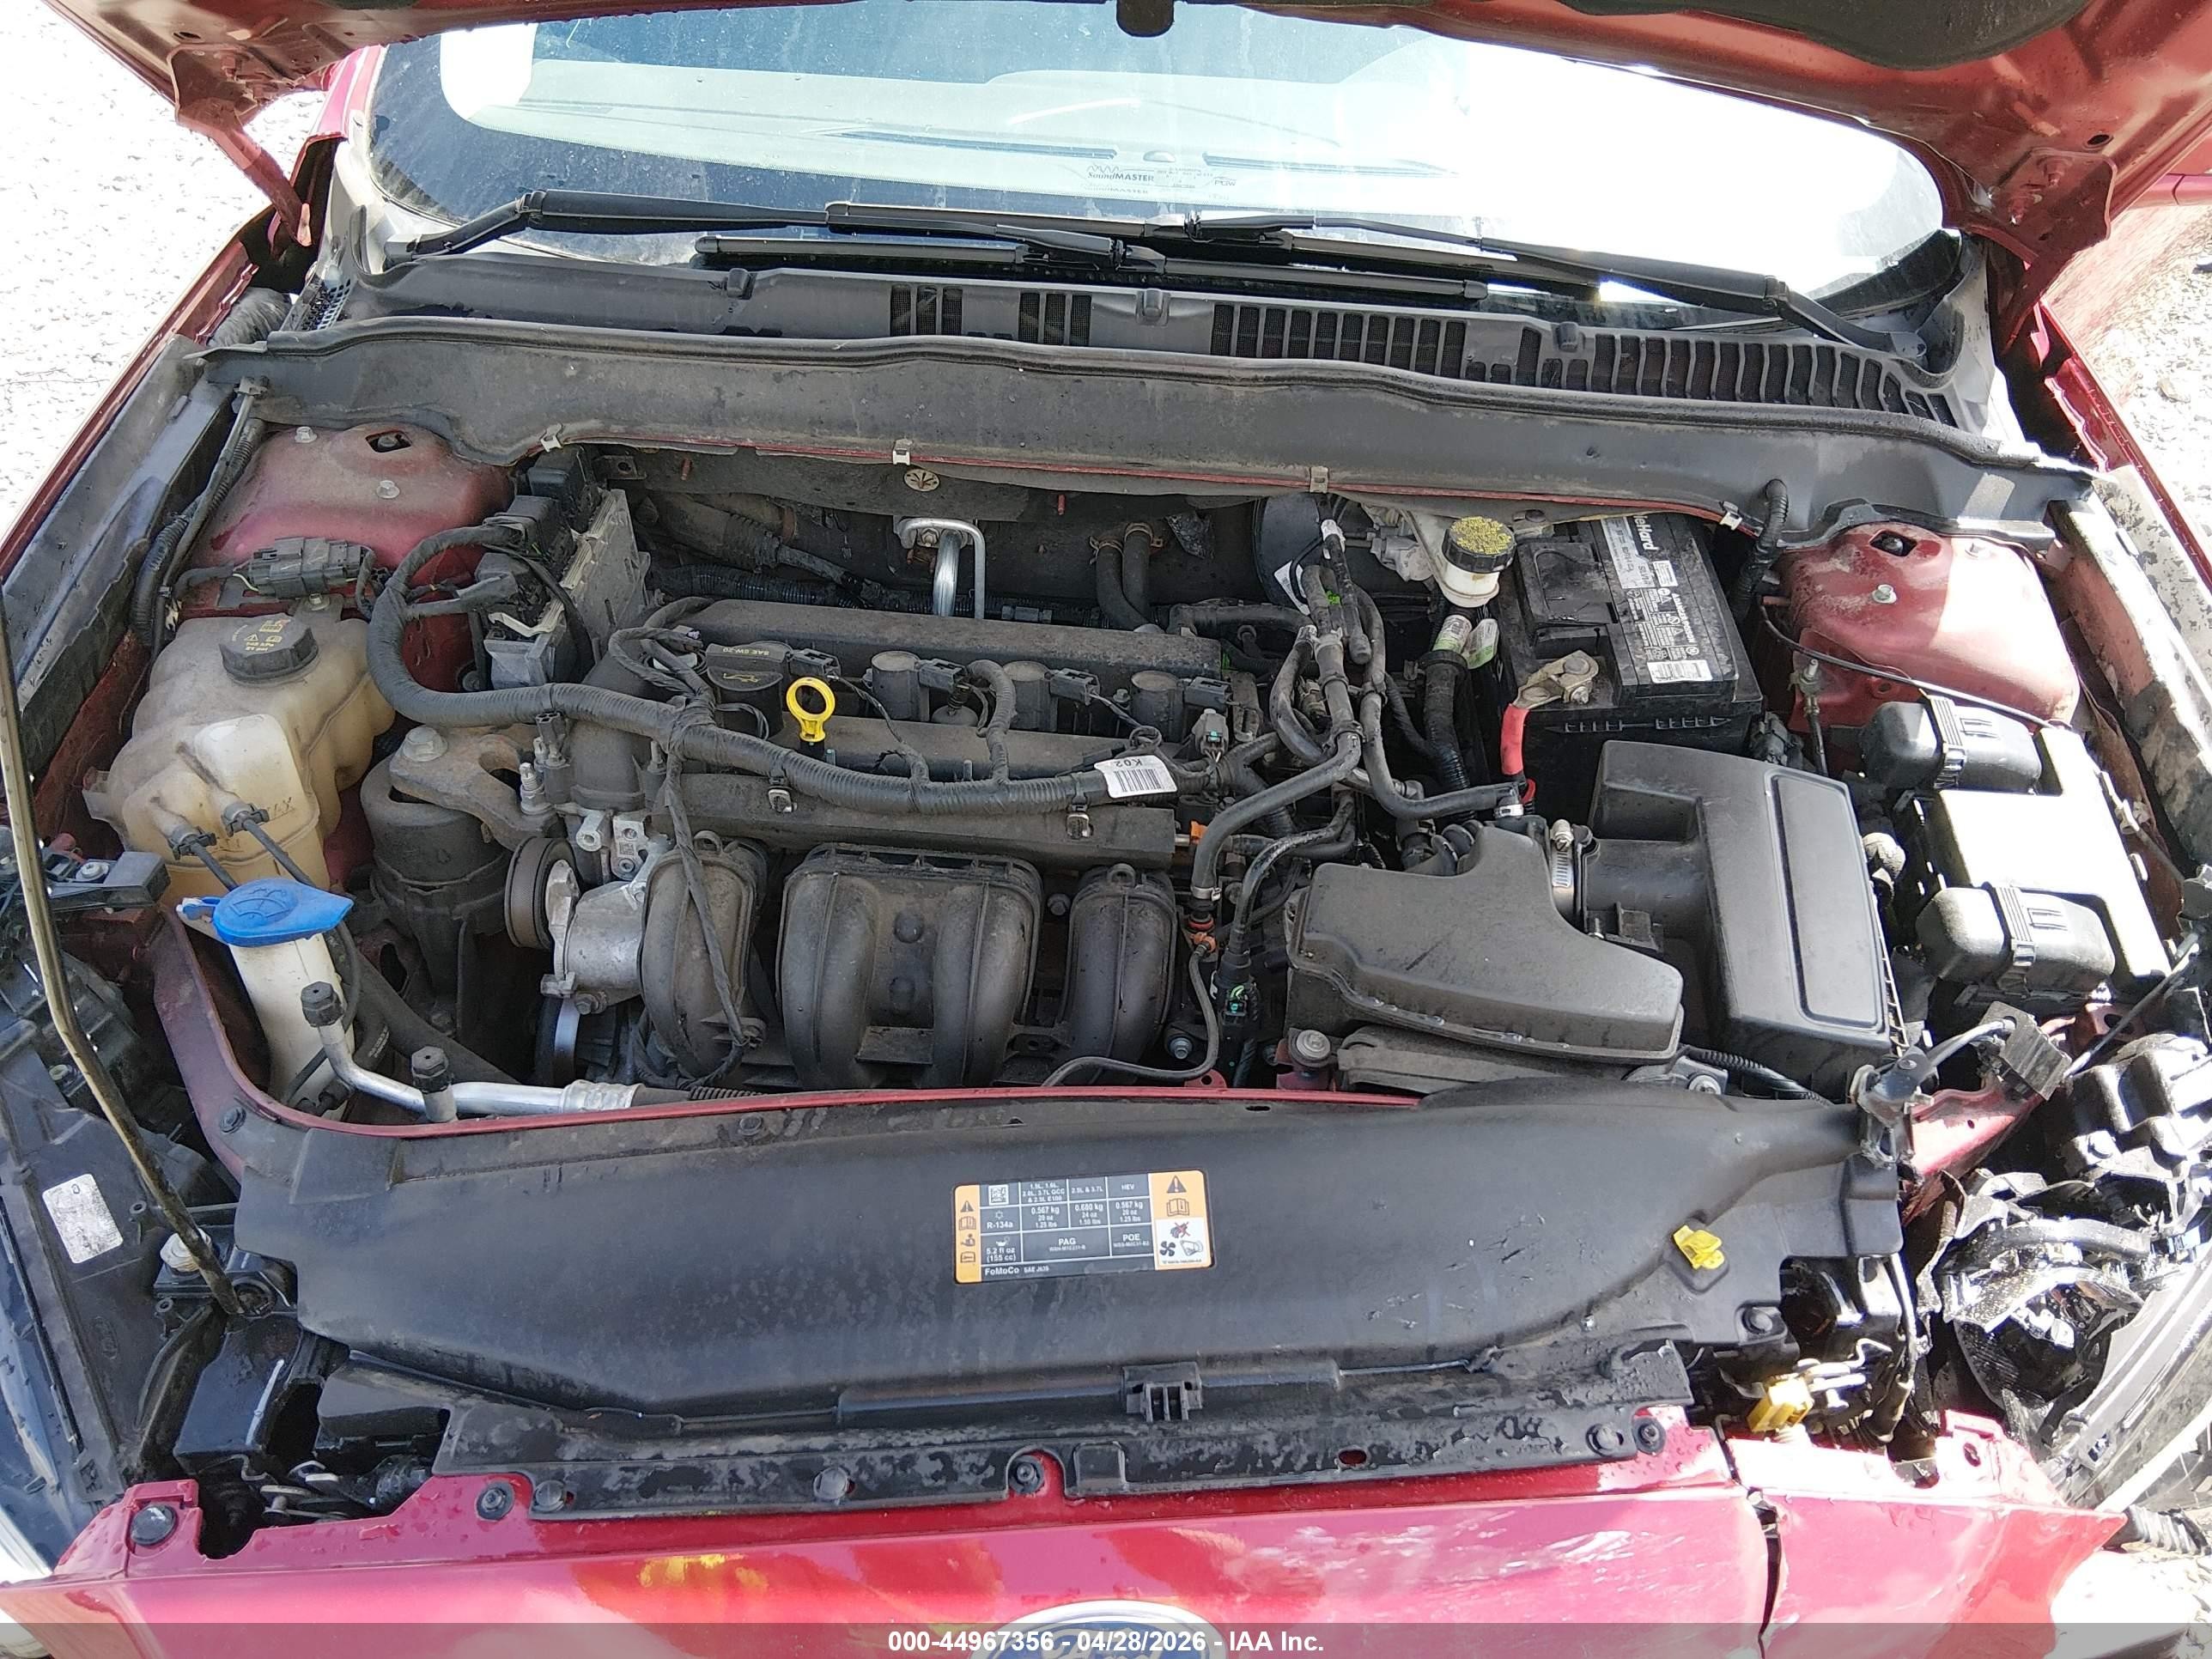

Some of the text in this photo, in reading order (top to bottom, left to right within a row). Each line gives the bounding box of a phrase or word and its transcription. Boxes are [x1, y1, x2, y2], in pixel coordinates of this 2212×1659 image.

[1632, 515, 1659, 551] ieHard
[1114, 758, 1143, 768] K02
[1094, 1203, 1103, 1212] kg
[1133, 1200, 1143, 1209] kg
[1050, 1206, 1060, 1215] kg
[987, 1221, 1013, 1230] R-134a
[1058, 1237, 1077, 1246] PAG
[1122, 1233, 1141, 1242] POE
[985, 1266, 1020, 1276] FoMoCo
